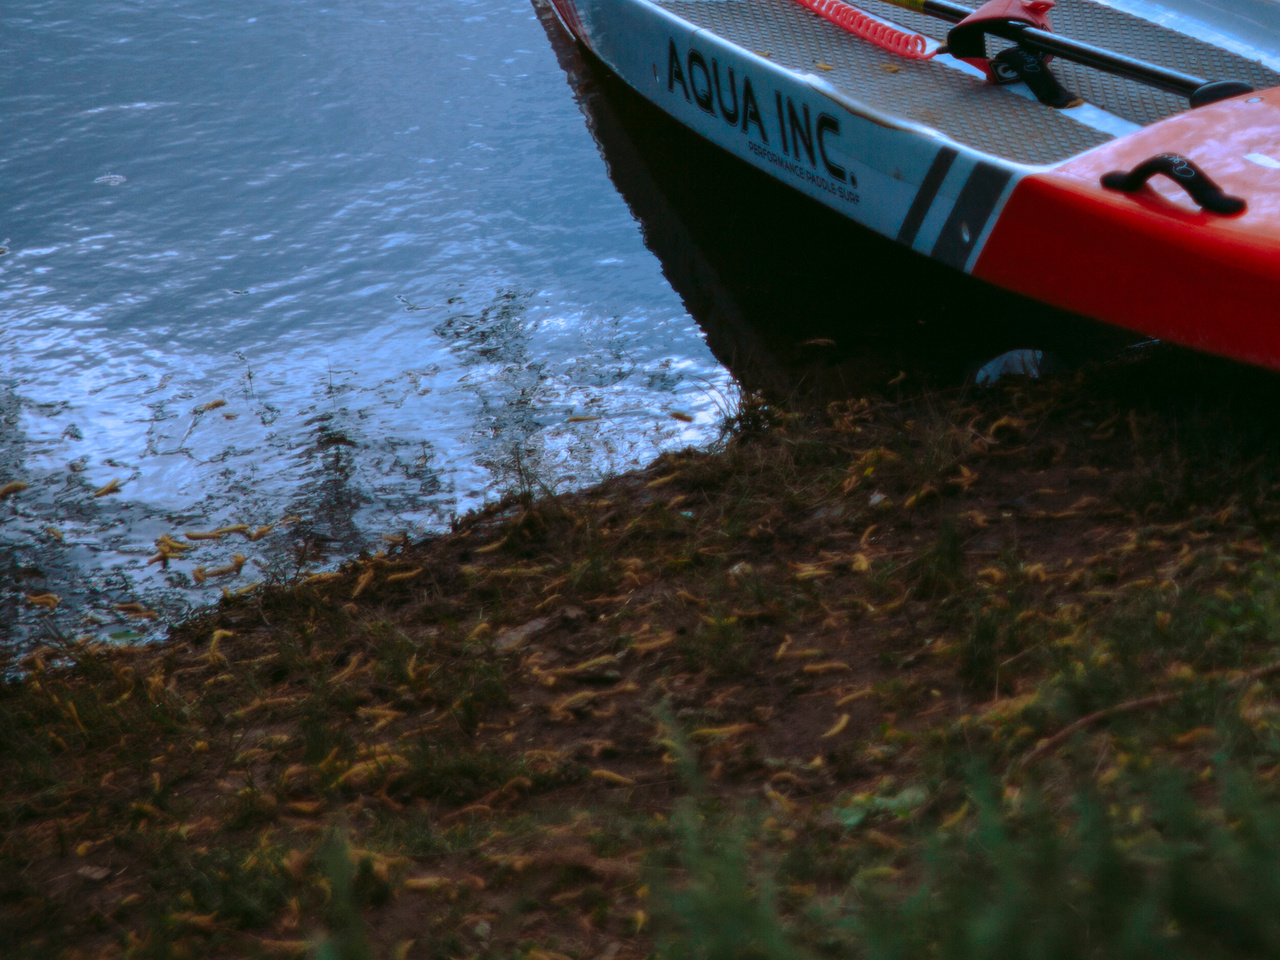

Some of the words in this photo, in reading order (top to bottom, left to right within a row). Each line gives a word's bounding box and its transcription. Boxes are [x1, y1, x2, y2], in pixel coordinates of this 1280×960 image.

[668, 37, 770, 146] AQUA
[775, 89, 858, 189] INC.
[748, 141, 805, 179] PERFORMANCE
[806, 170, 836, 195] PADDLE
[838, 186, 860, 206] SURF
